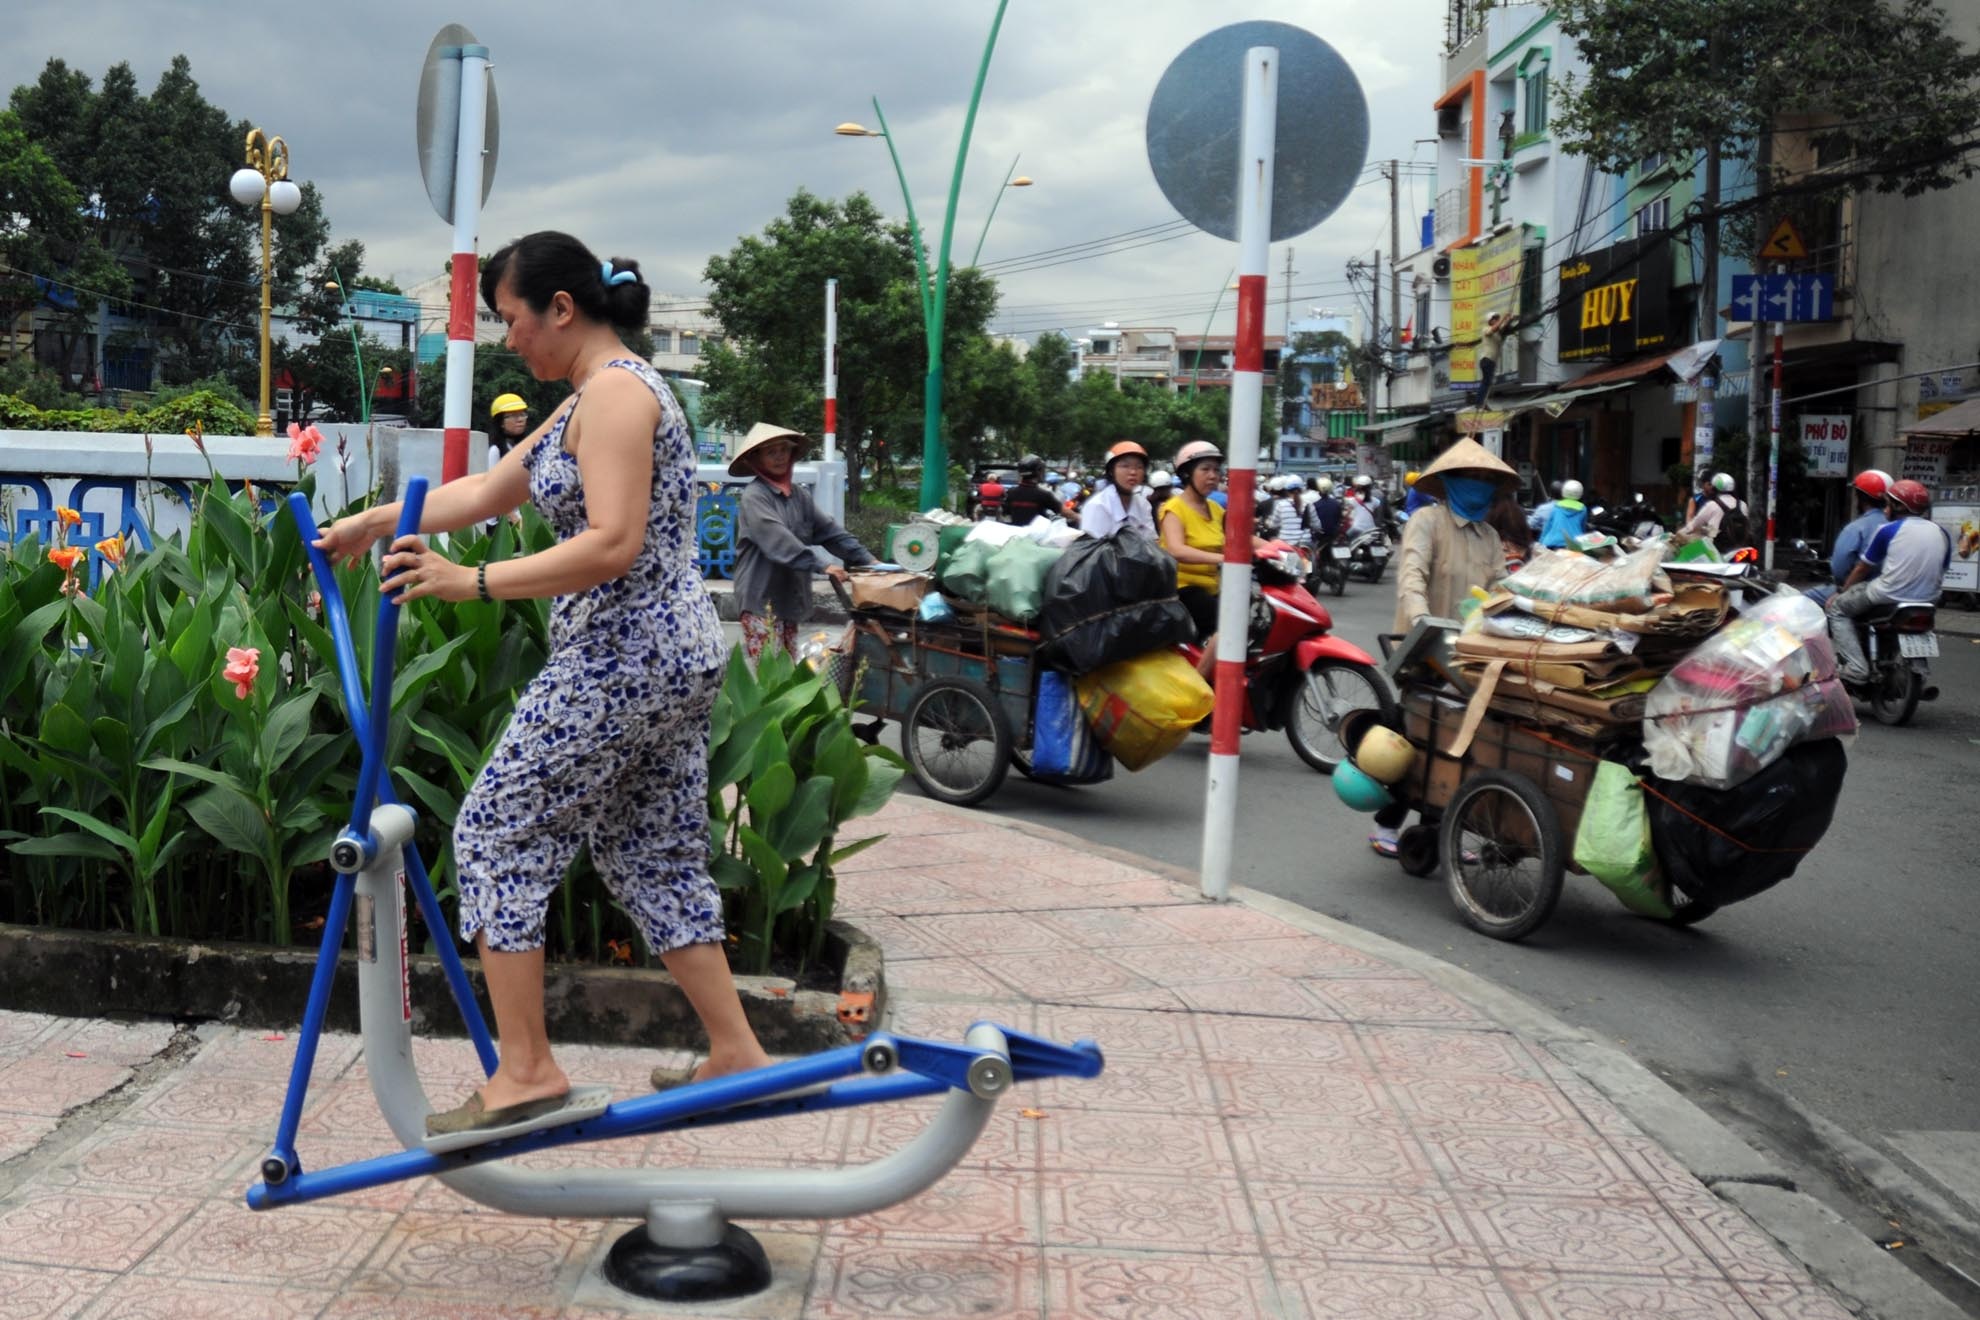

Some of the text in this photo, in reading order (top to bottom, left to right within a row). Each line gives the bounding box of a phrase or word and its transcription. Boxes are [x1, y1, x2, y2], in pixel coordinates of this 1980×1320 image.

[1581, 278, 1638, 330] HUY
[1805, 418, 1848, 440] PHỞ BÒ
